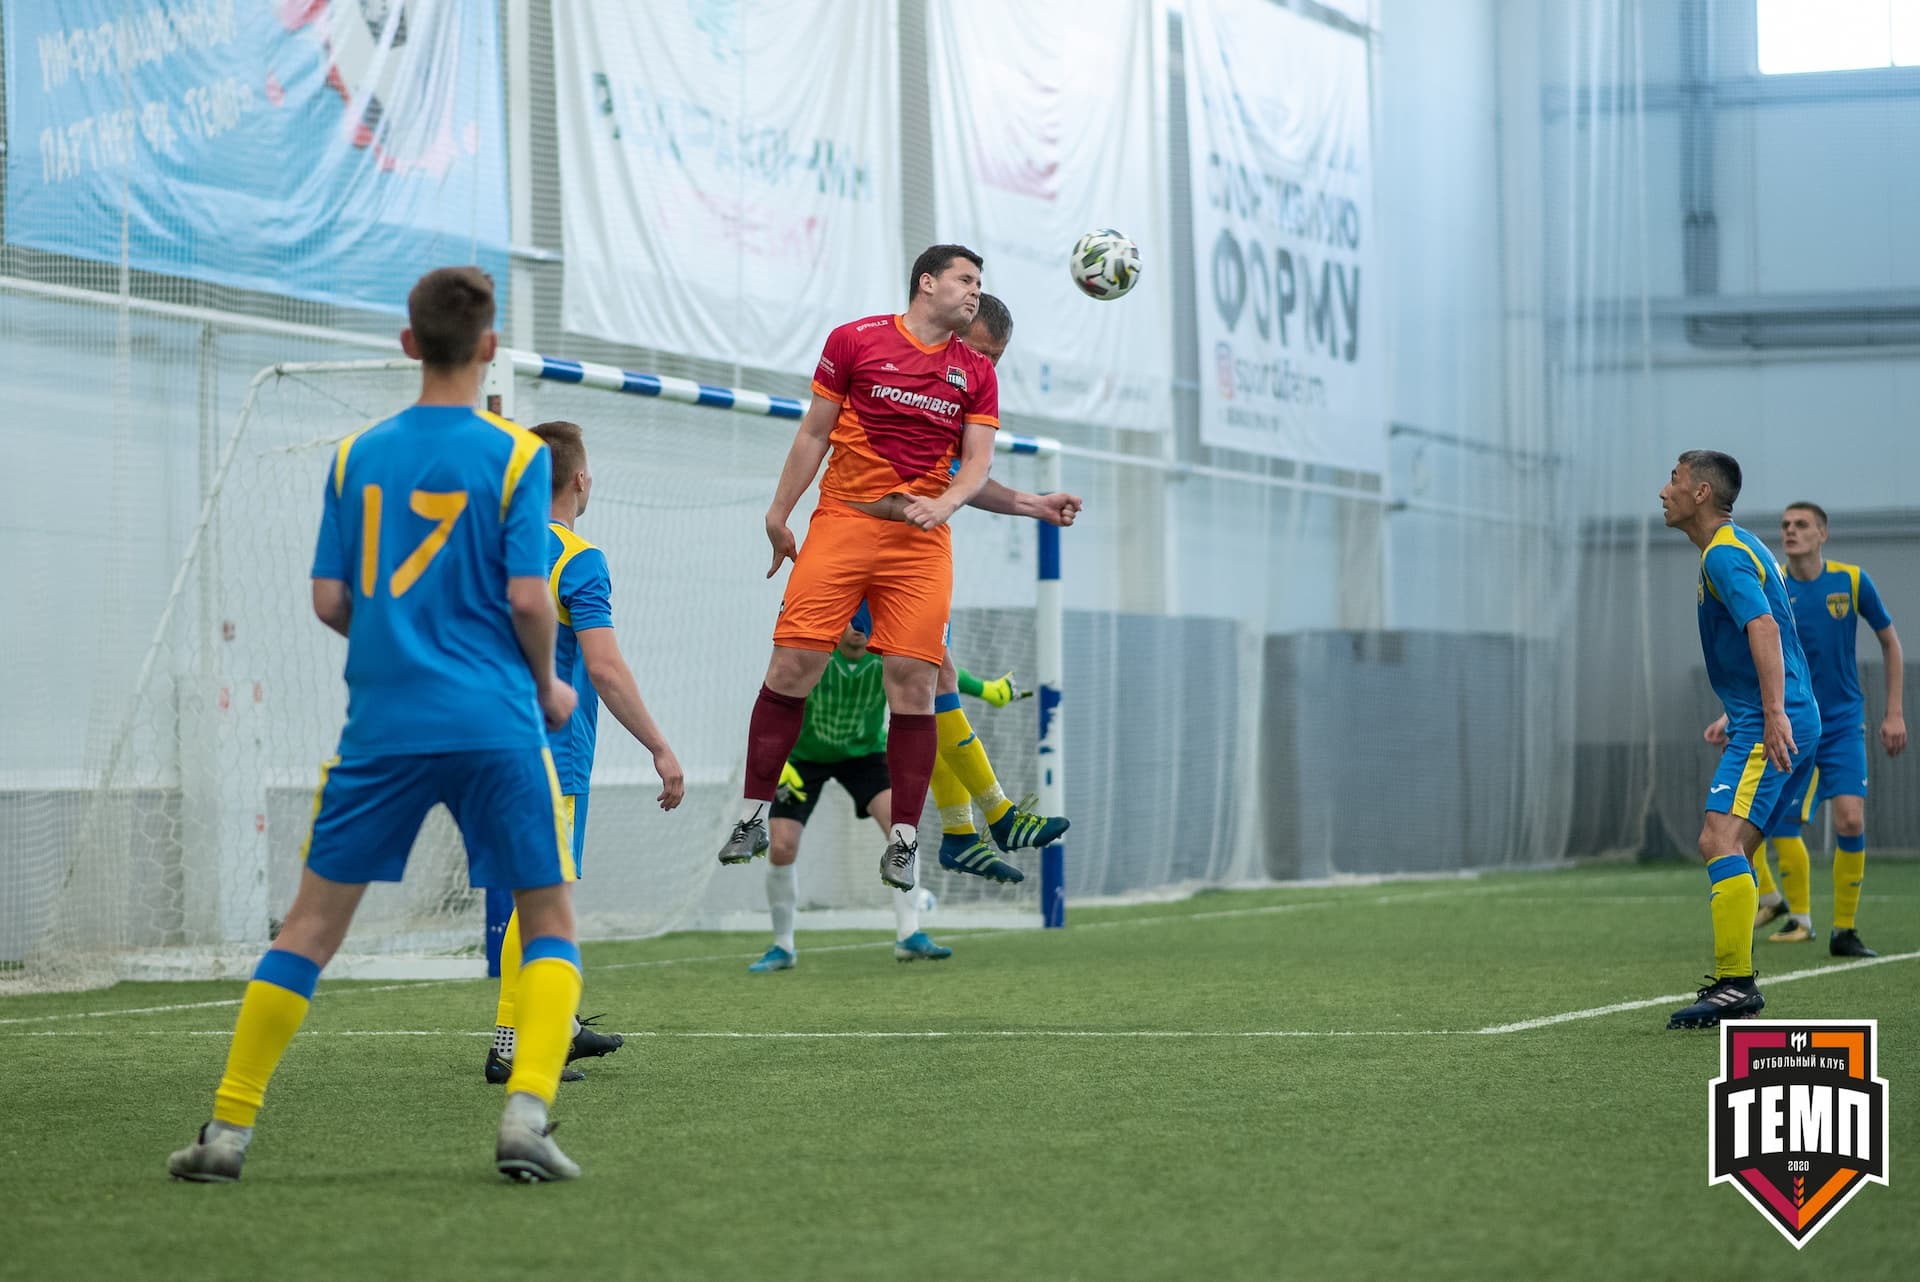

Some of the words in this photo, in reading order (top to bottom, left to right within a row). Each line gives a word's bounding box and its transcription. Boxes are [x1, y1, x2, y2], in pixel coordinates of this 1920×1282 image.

[1210, 227, 1361, 364] ФОРМУ
[870, 384, 961, 417] ПРОДИНВЕСТ
[360, 483, 468, 598] 17
